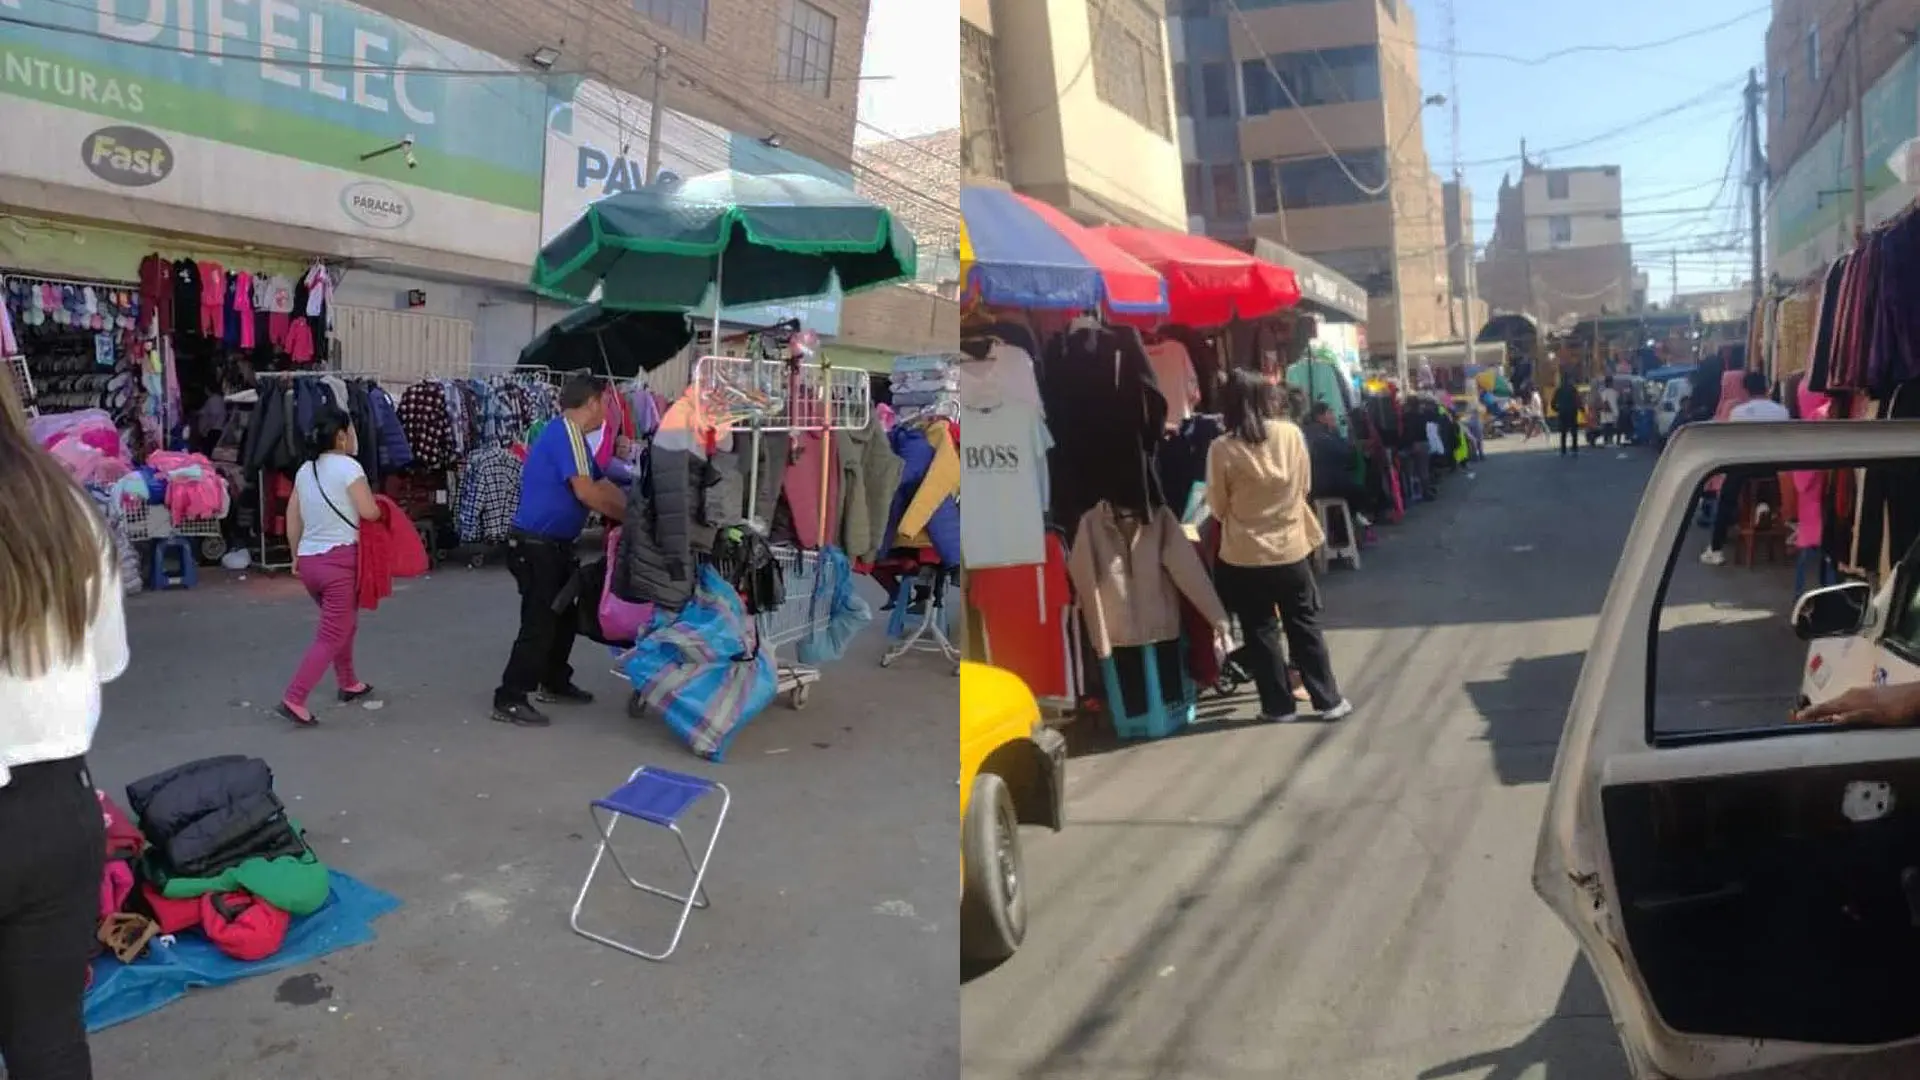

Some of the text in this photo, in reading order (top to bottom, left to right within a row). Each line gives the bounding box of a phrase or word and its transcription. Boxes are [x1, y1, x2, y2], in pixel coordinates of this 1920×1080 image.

[0, 51, 144, 113] NTURAS
[91, 135, 165, 177] Fast
[353, 195, 404, 215] PARACAS
[966, 445, 1019, 469] BOSS
